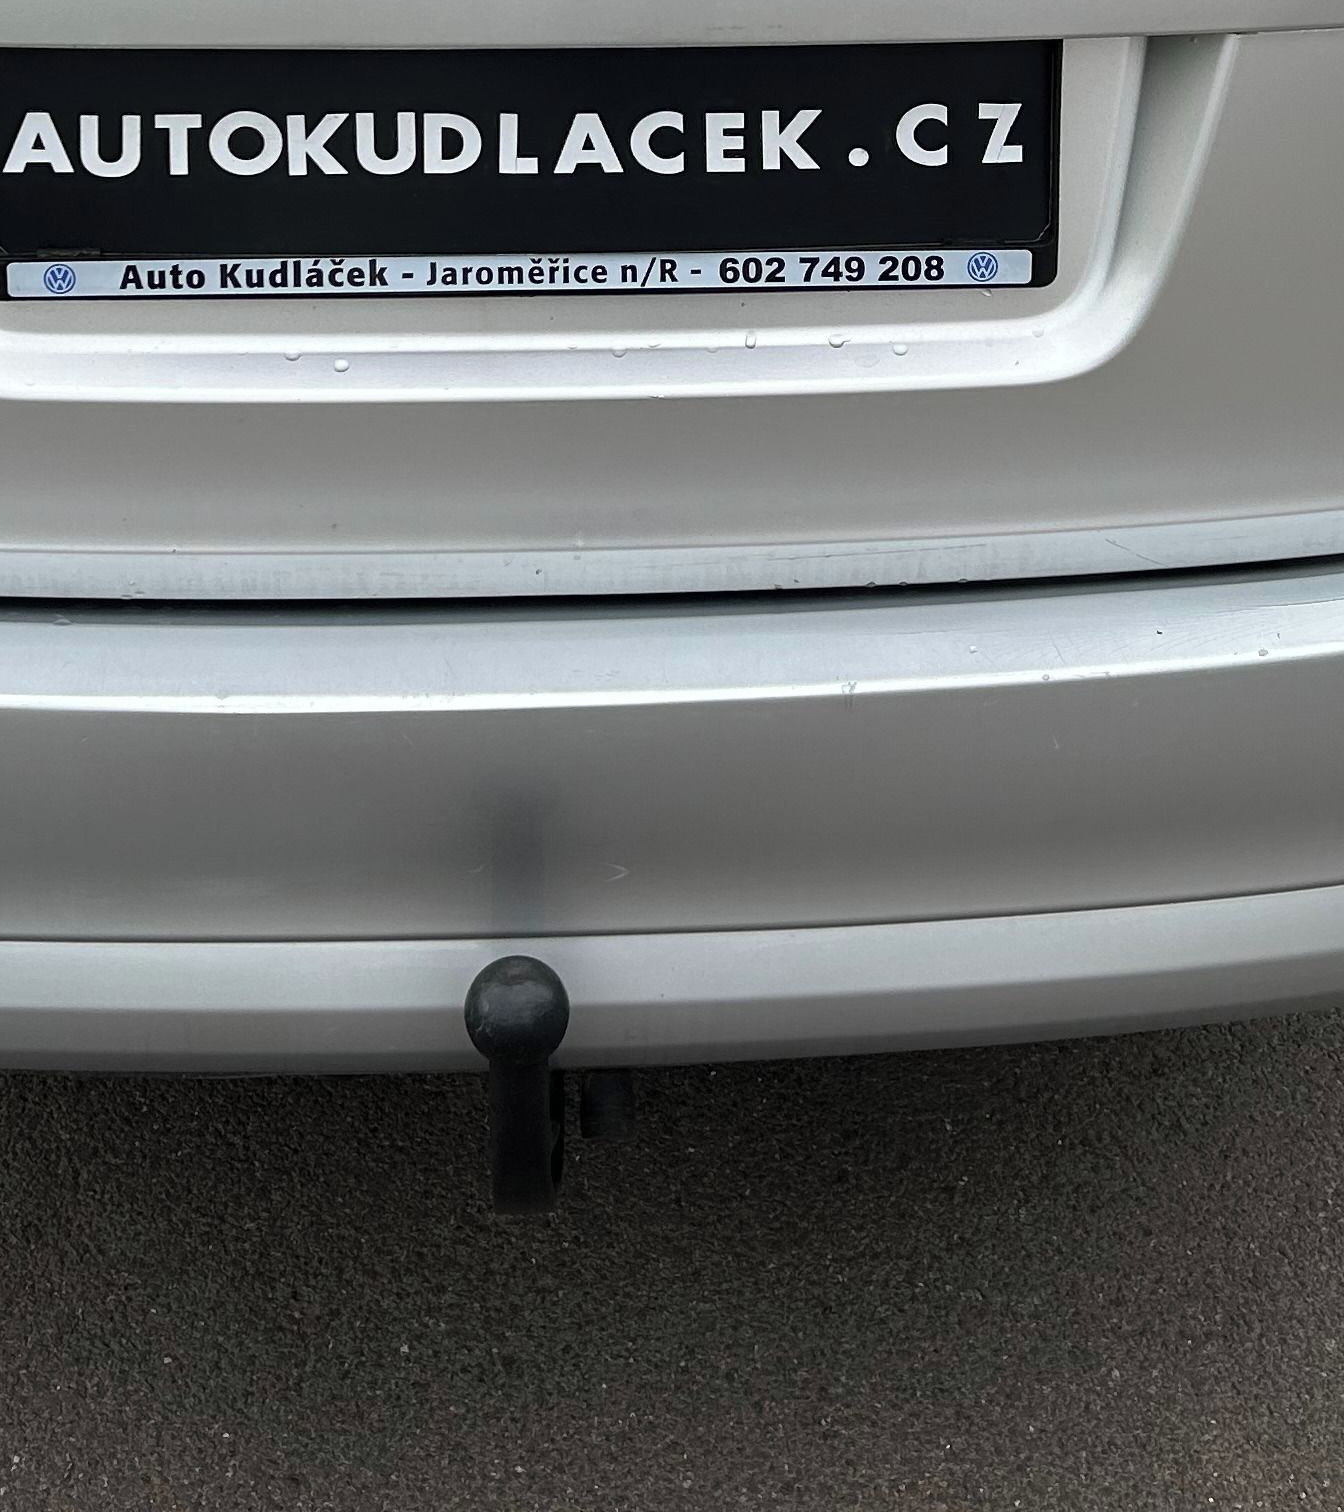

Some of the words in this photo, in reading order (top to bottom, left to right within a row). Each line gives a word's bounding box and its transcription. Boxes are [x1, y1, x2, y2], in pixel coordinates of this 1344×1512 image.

[119, 263, 206, 290] Auto
[219, 258, 389, 289] Kudláček
[426, 257, 608, 286] Jaroměřice
[620, 256, 679, 288] n/R
[719, 257, 786, 284] 602
[798, 256, 866, 283] 749
[877, 255, 945, 282] 208
